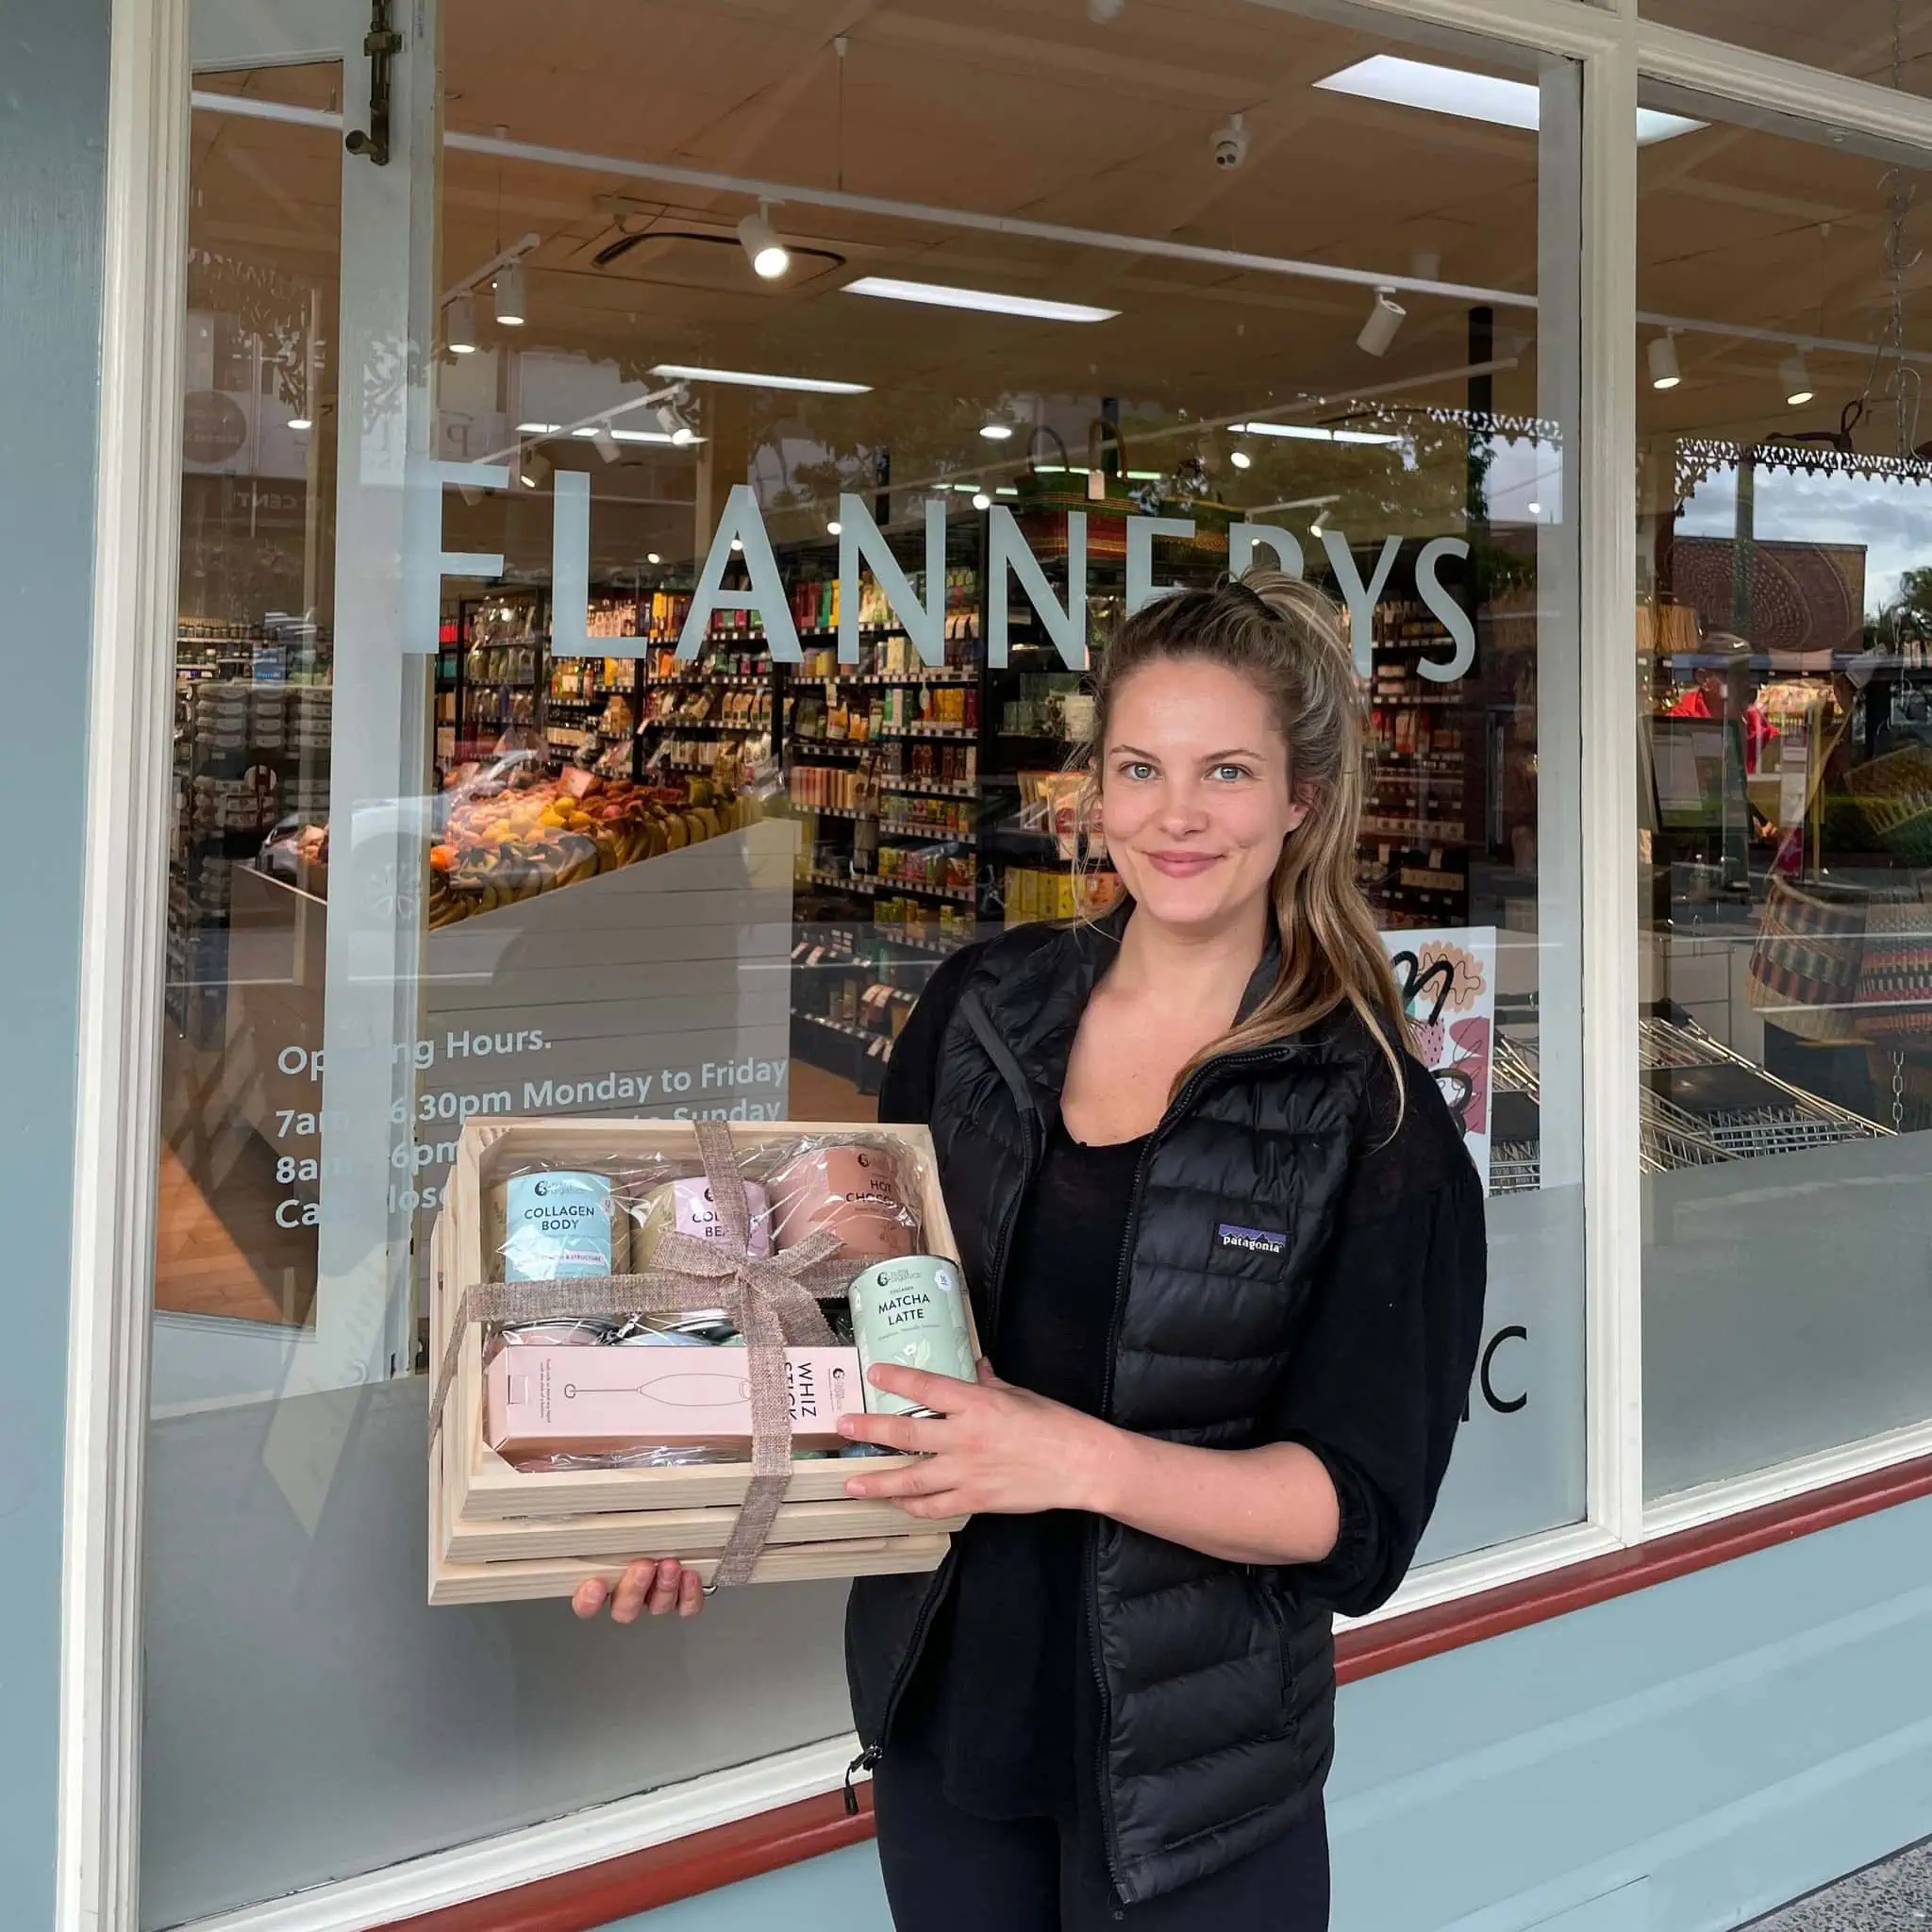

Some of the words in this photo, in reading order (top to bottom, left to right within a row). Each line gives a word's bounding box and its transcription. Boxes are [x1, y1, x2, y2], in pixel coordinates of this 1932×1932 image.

[446, 1029, 552, 1058] Hours.
[524, 1072, 653, 1109] Monday
[661, 1070, 691, 1092] to
[701, 1057, 789, 1088] Friday
[524, 1205, 595, 1220] COLLAGEN
[541, 1219, 579, 1231] BODY
[1223, 1236, 1281, 1253] patagonia
[878, 1293, 931, 1314] MATCHA
[888, 1308, 924, 1325] LATTE
[797, 1362, 817, 1417] WHIZ
